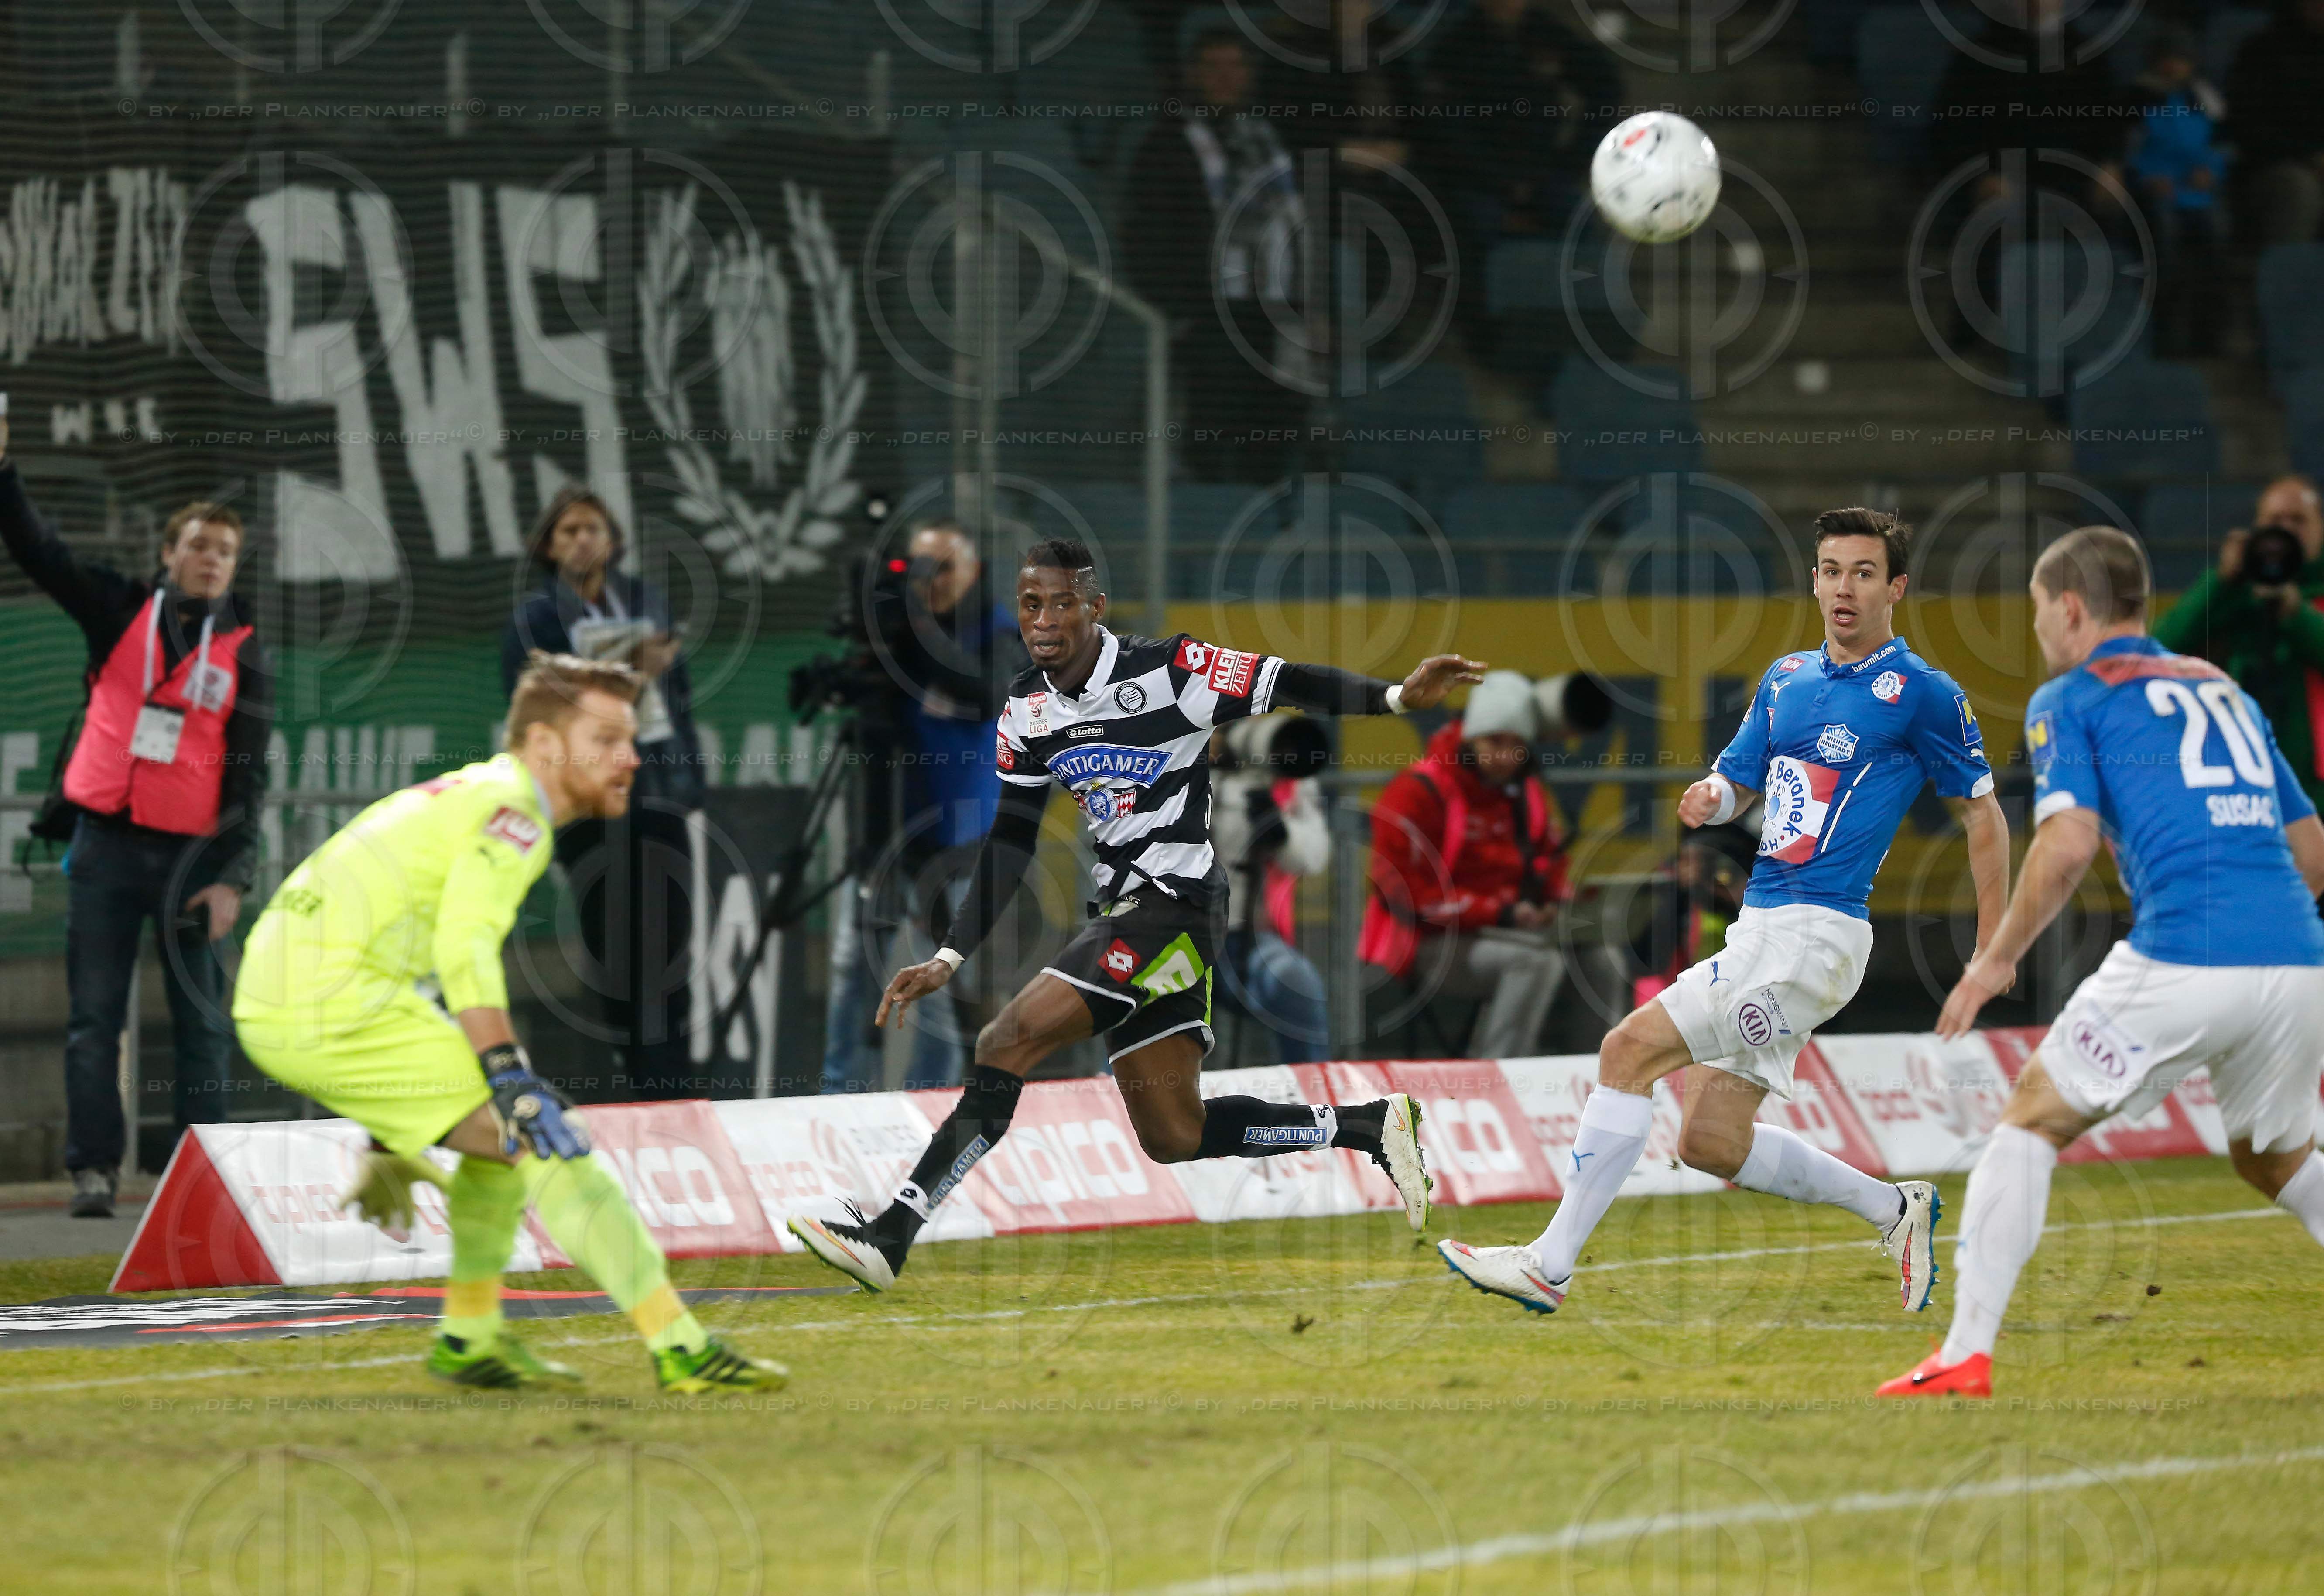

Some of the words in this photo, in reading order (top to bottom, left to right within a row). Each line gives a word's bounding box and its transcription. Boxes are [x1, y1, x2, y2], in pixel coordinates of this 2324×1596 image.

[1852, 645, 1896, 673] baumit.com
[1030, 725, 1049, 734] LIGA
[1077, 727, 1102, 736] lotto
[2145, 679, 2276, 788] 20
[1821, 740, 1850, 755] NEUSTADT
[1826, 735, 1848, 748] WIENER
[1776, 760, 1805, 836] Beranek
[1742, 1009, 1766, 1042] KIA
[1249, 1130, 1323, 1142] PUNTIGAMER
